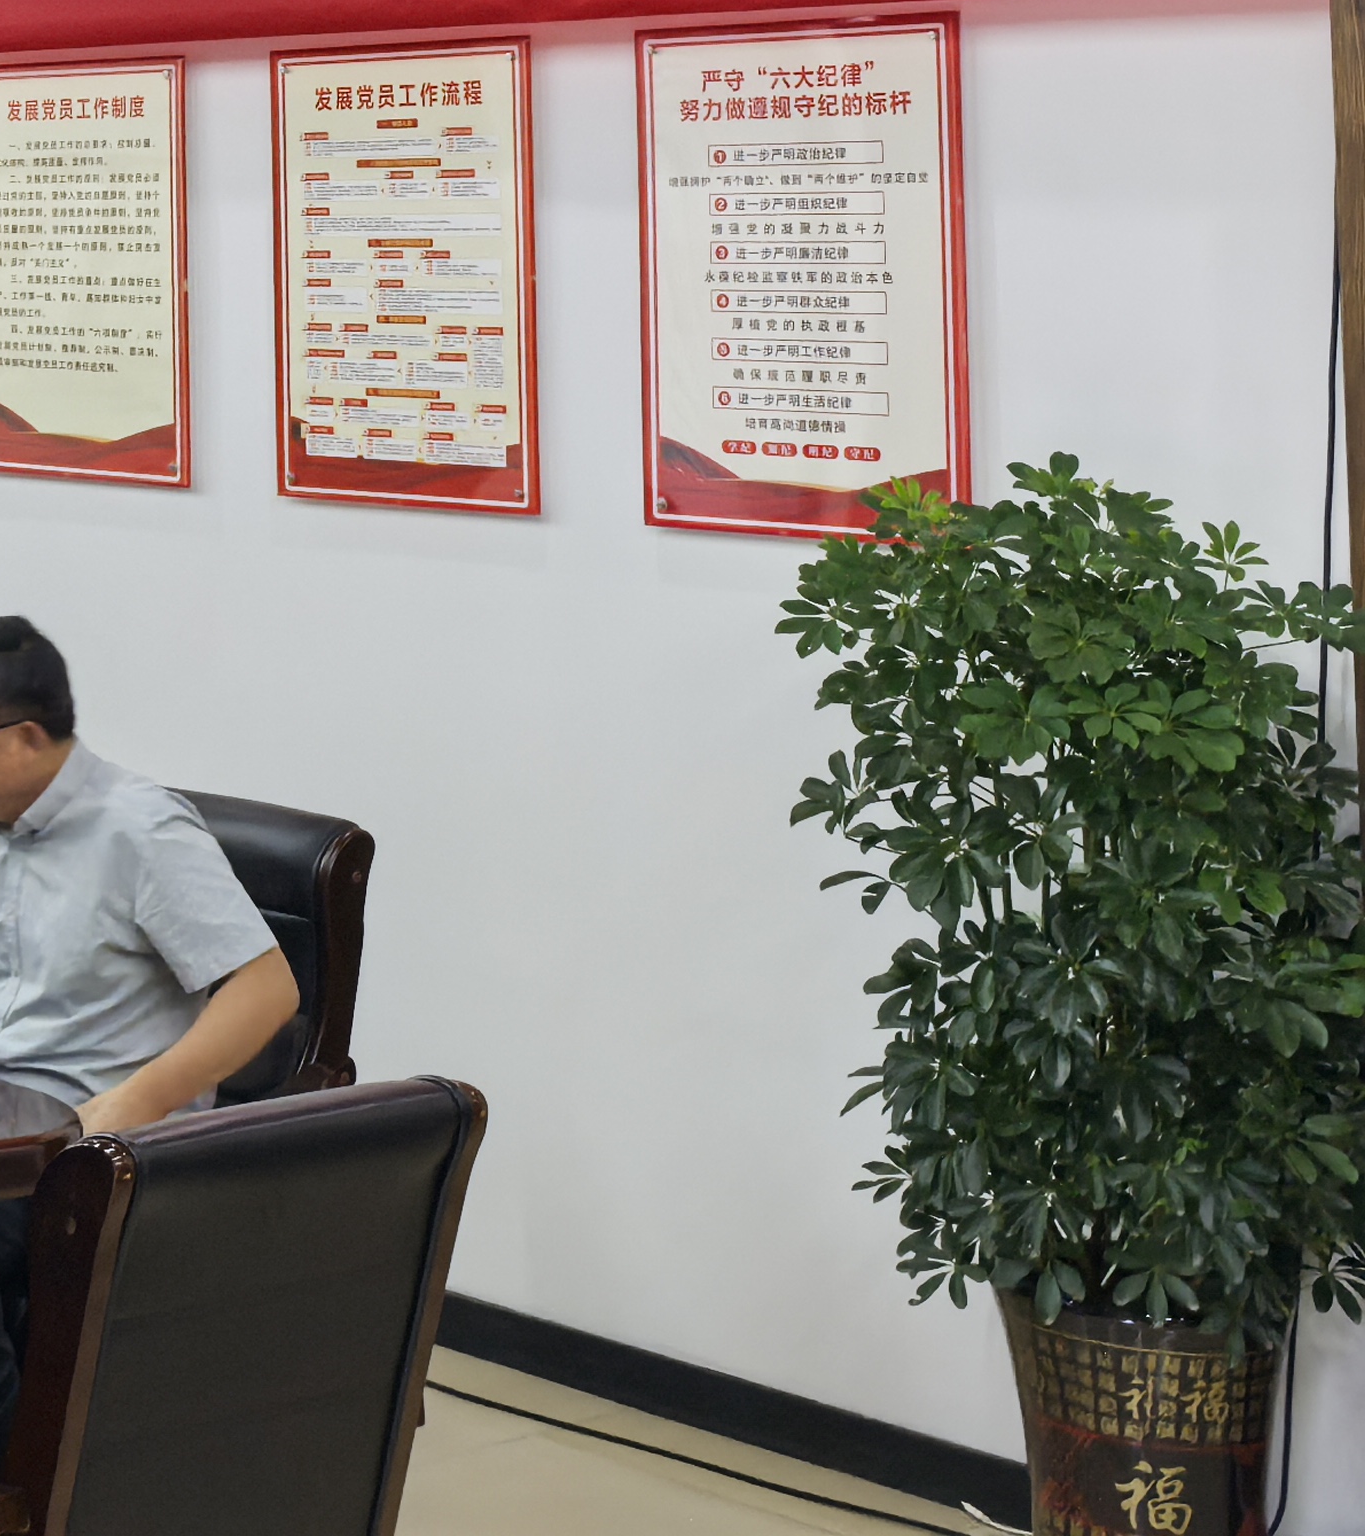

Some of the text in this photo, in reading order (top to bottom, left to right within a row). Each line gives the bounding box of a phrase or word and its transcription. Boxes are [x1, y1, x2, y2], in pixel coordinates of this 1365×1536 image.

[314, 80, 484, 111] 发展党员工作流程
[7, 95, 146, 122] 发展党员工作制度
[679, 90, 913, 122] 努力做遵规守纪的标杆
[733, 147, 847, 162] 进一步严明政治纪律
[734, 197, 848, 211] 进一步严明组织纪律
[736, 295, 850, 309] 进一步严明群众纪律
[737, 344, 851, 359] 进一步严明工作纪律
[738, 392, 852, 409] 进一步严明生活纪律
[1114, 1460, 1193, 1536] 福
